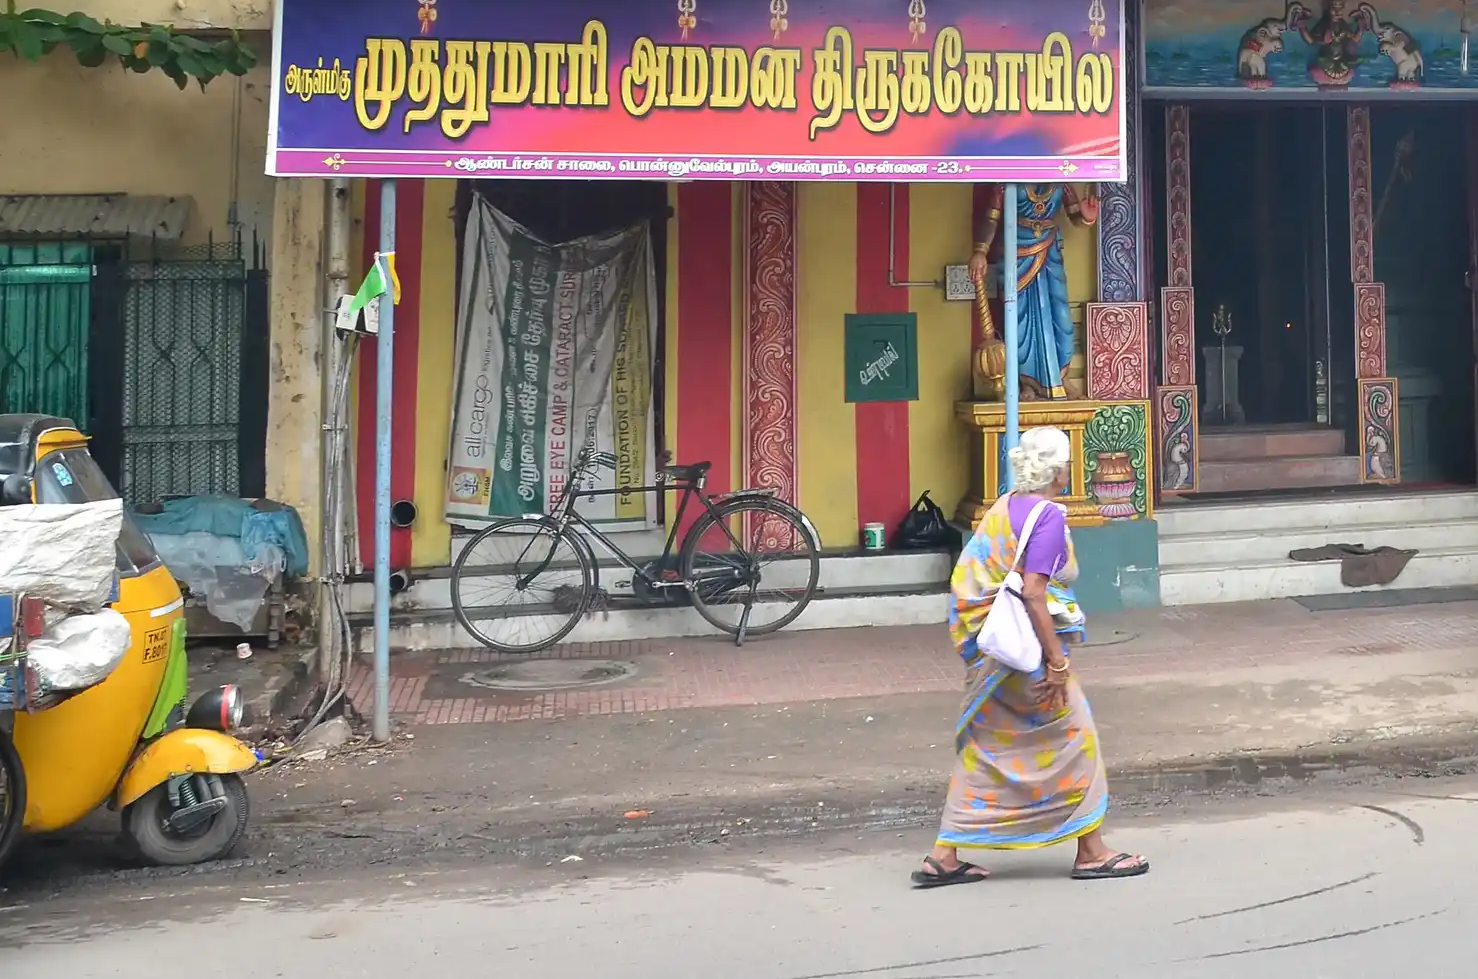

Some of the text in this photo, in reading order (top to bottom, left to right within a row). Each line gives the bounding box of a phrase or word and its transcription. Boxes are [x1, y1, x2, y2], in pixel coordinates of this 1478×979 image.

[285, 56, 352, 102] அருள்மிகு
[554, 301, 574, 376] CATARACT
[553, 379, 567, 390] &
[616, 383, 629, 404] OF
[551, 394, 567, 435] CAMP
[550, 439, 566, 469] EYE
